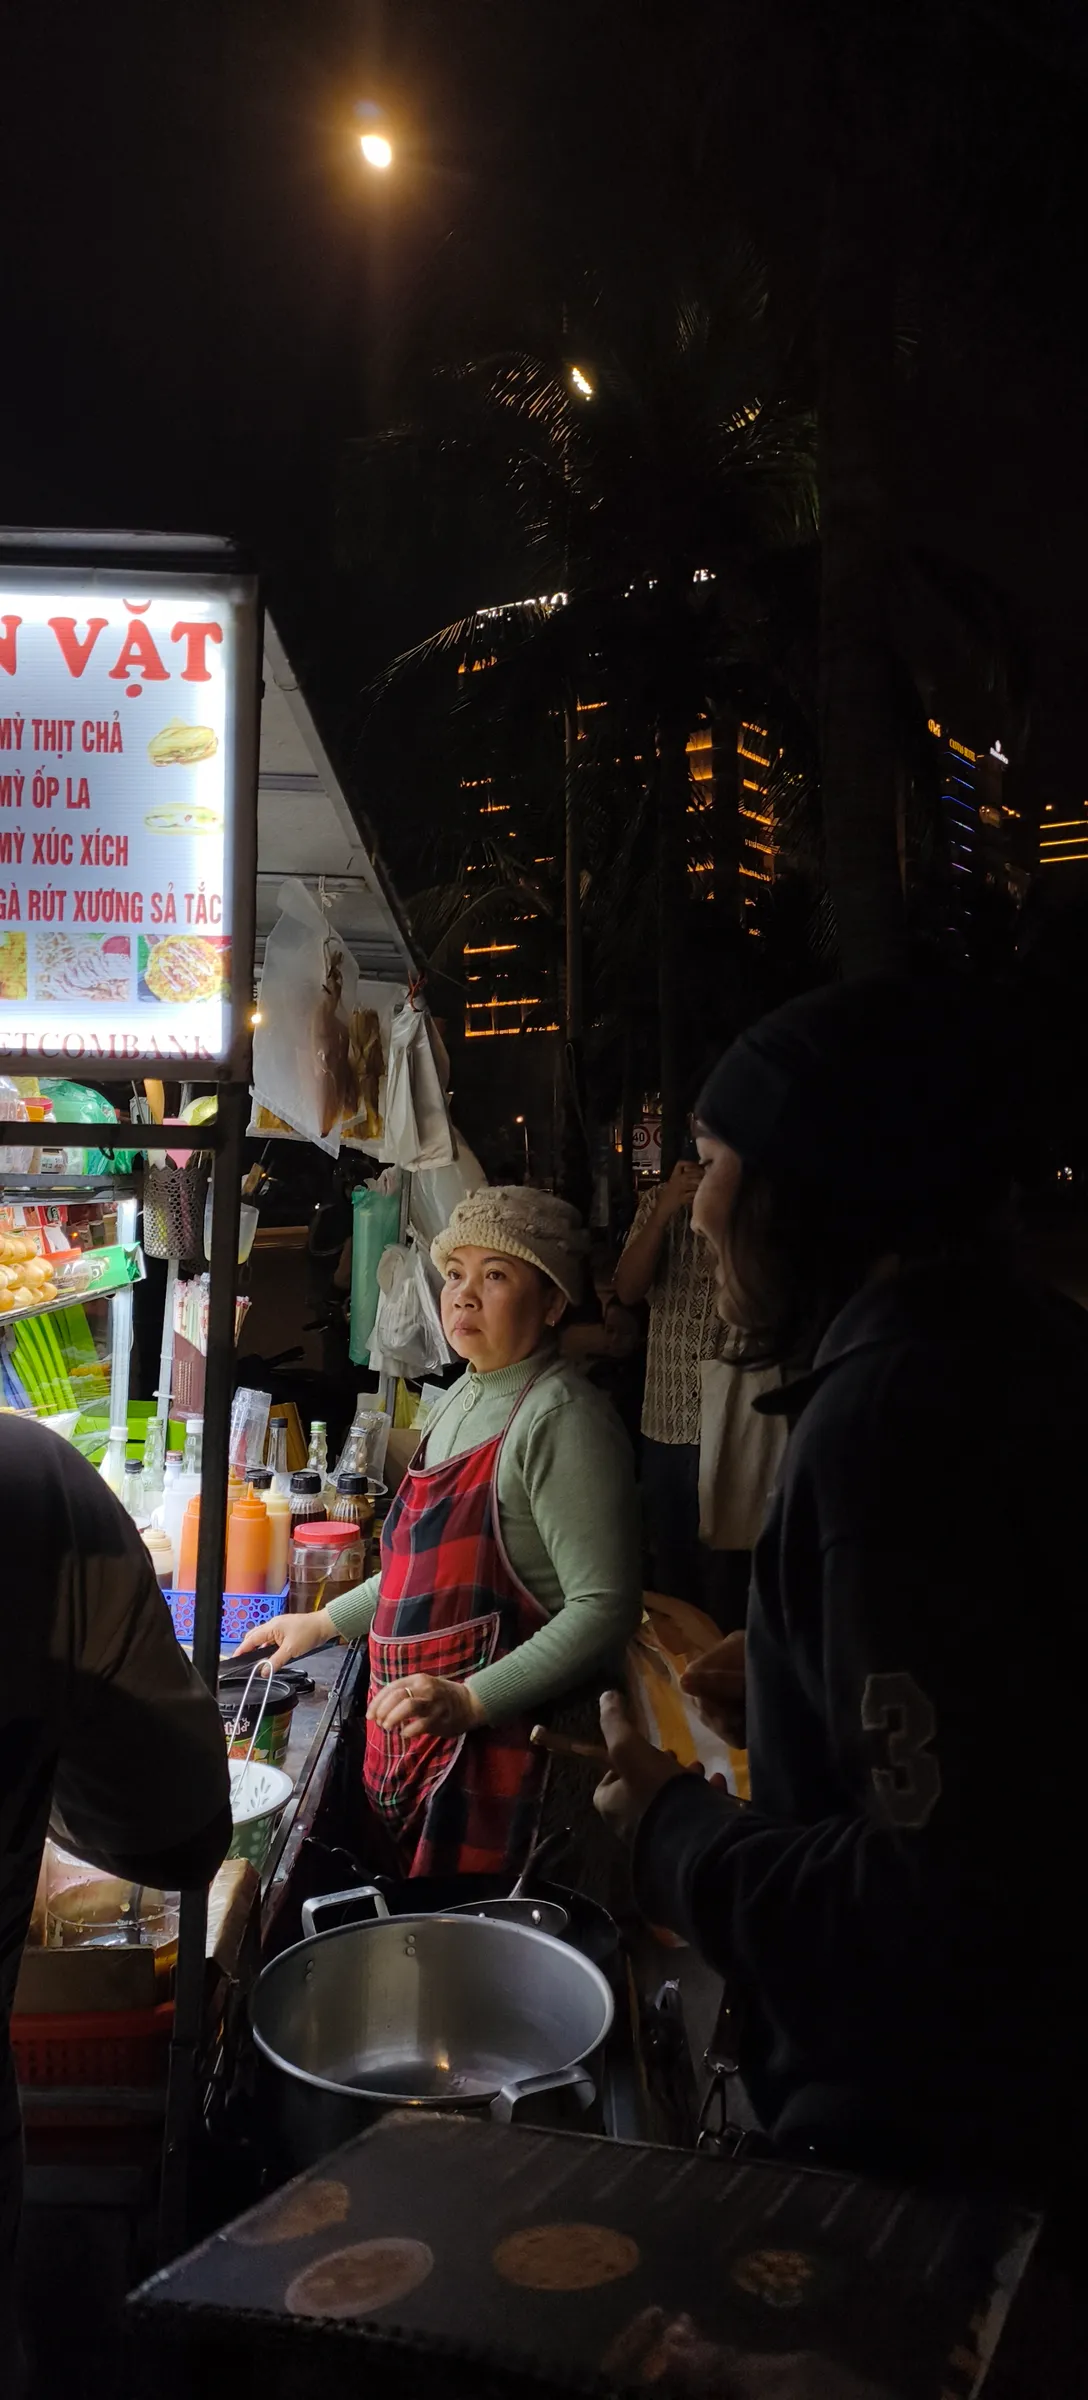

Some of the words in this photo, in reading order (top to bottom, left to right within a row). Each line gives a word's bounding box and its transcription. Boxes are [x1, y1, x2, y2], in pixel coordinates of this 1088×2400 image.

[48, 598, 223, 698] VẶT
[32, 719, 75, 759] THỊT
[82, 710, 123, 753] CHẢ
[32, 765, 60, 808] ỐP
[66, 777, 91, 809] LA
[32, 827, 73, 865] XÚC
[80, 828, 129, 867] XÍCH
[28, 883, 67, 921] RÚT
[73, 888, 144, 923] XƯƠNG
[151, 882, 177, 924] SẢ
[184, 881, 222, 924] TẮC
[861, 1672, 942, 1828] 3
